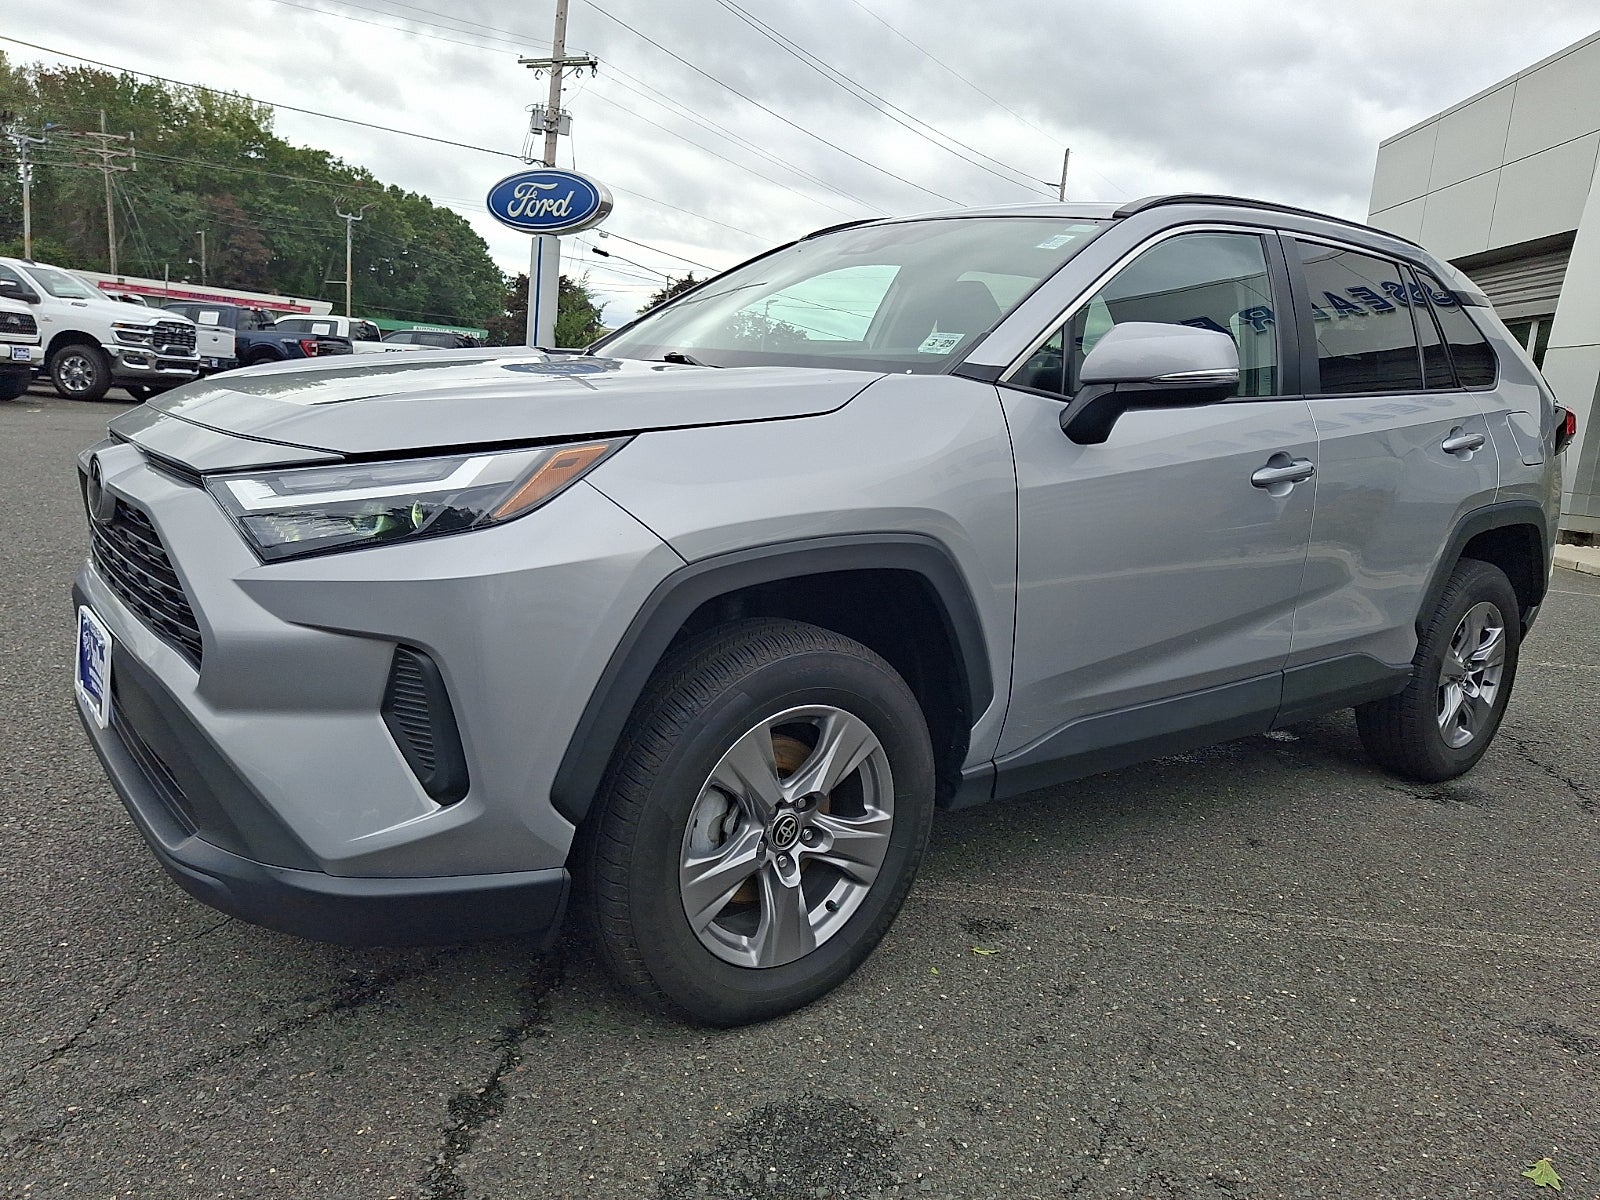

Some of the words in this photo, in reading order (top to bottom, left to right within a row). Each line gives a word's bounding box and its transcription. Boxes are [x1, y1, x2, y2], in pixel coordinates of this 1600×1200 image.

[507, 181, 575, 218] Ford
[927, 338, 938, 347] 3
[939, 339, 955, 348] 29
